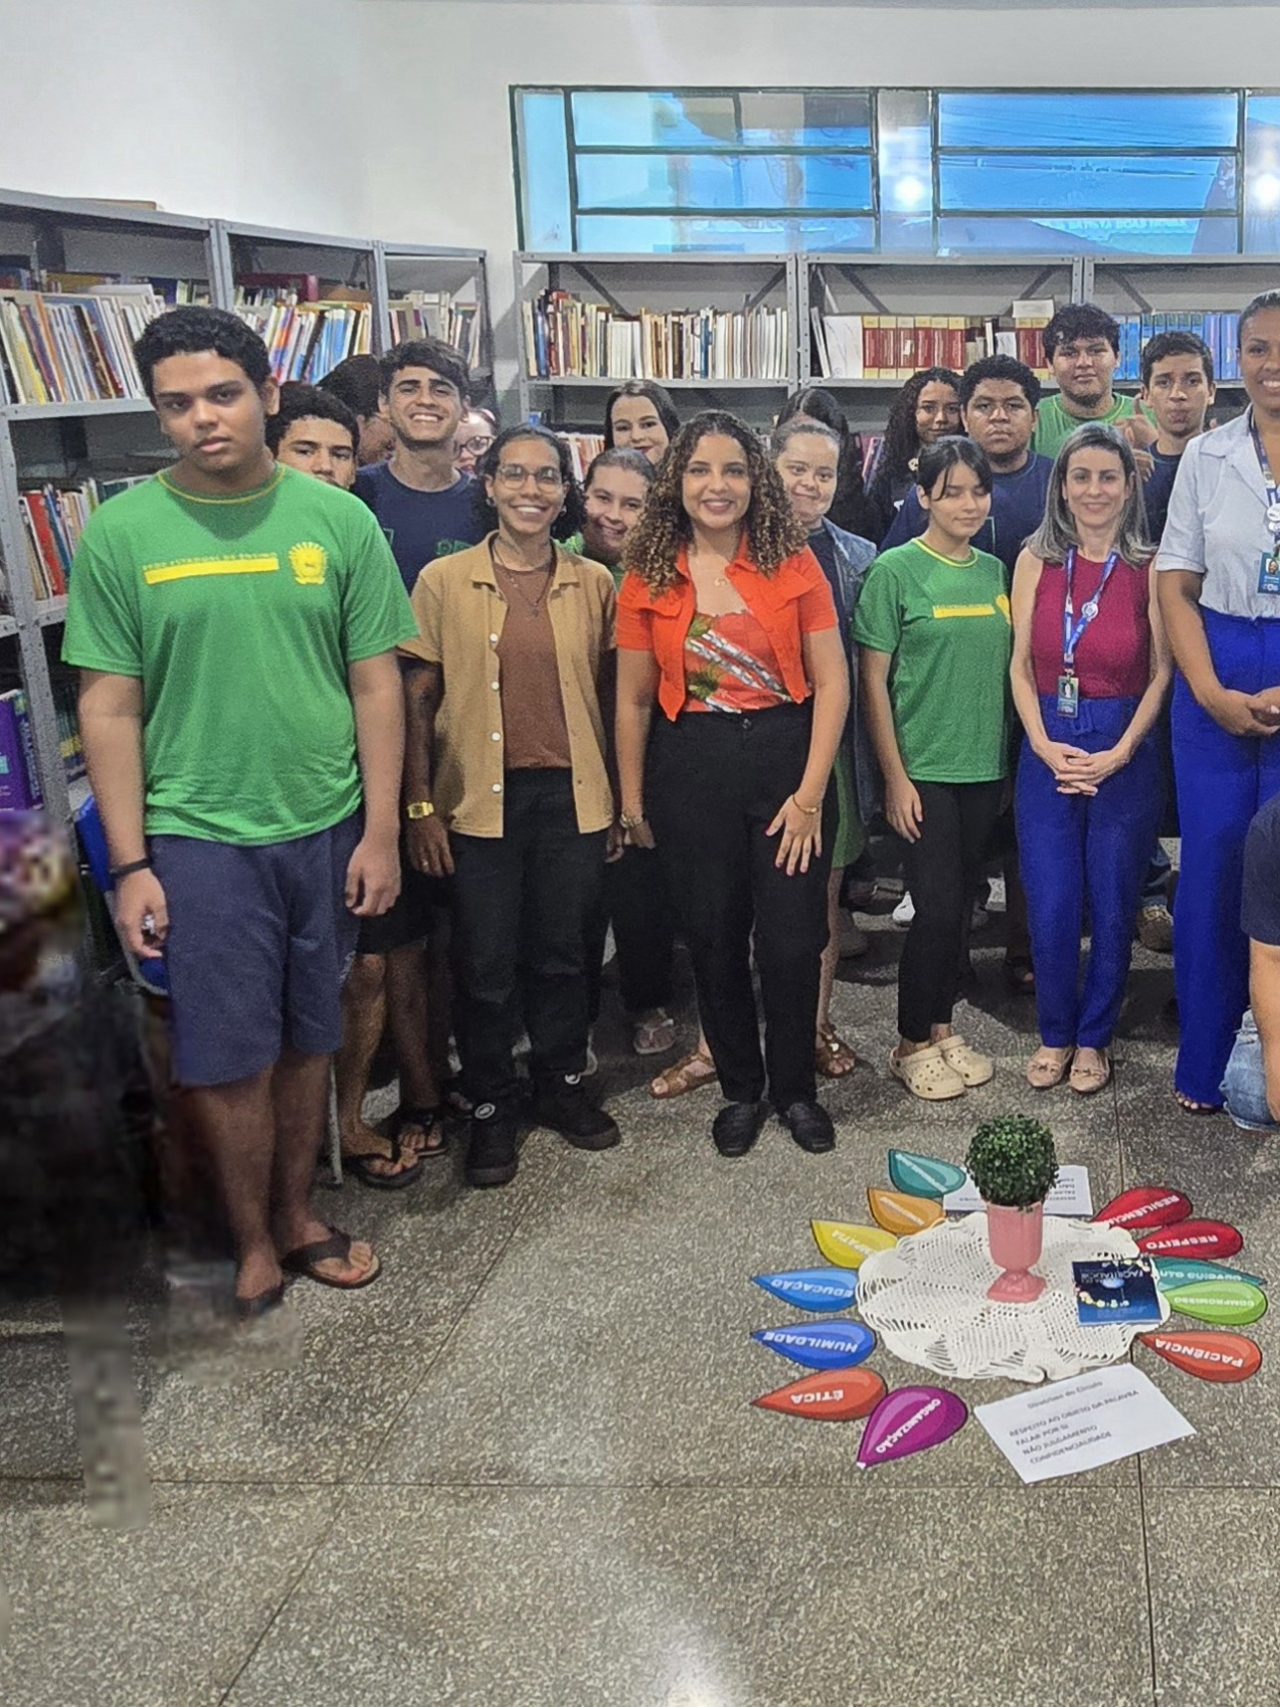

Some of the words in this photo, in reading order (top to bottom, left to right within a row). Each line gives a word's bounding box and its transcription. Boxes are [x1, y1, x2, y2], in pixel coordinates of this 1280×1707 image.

[1146, 1234, 1218, 1250] RESPEITO
[1159, 1270, 1185, 1279] UTO
[770, 1278, 854, 1298] EDUCAÇÃO
[1174, 1296, 1256, 1308] COMPROMISSO
[763, 1331, 859, 1353] HUMILDADE
[1154, 1337, 1244, 1369] PACIÊNCIA
[790, 1389, 844, 1404] ÉTICA
[875, 1398, 941, 1454] ORGANIZAÇÃO
